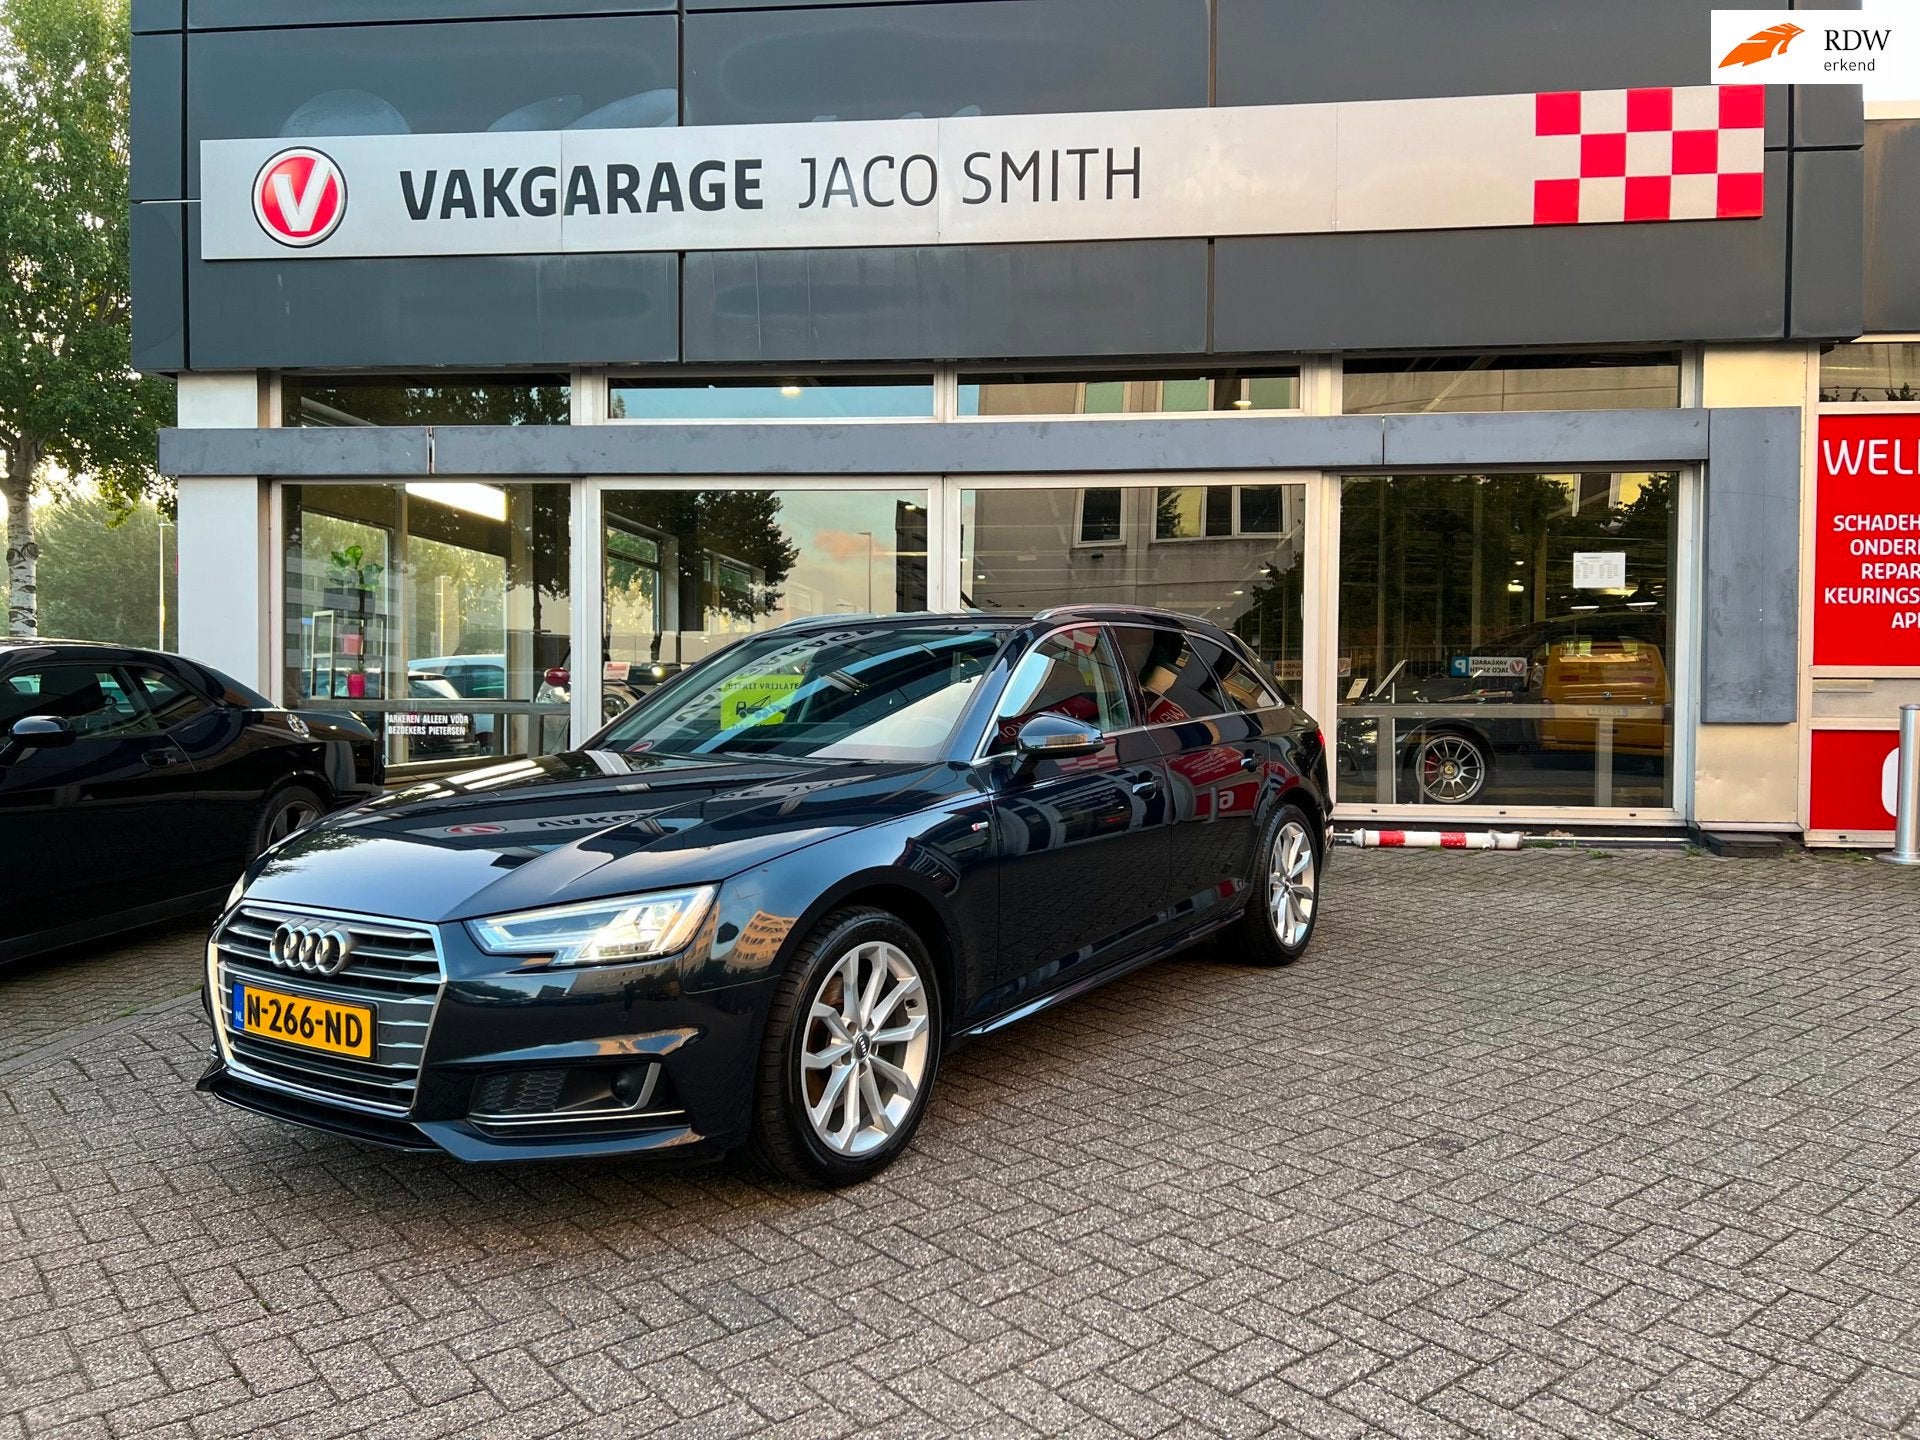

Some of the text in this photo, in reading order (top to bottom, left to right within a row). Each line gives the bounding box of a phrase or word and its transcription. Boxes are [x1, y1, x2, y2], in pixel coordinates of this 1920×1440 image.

[400, 147, 1141, 220] VAKGARAGE JACO SMITH
[1823, 439, 1920, 476] WEL
[1850, 538, 1920, 556] ONDER
[1891, 611, 1920, 629] AP
[422, 714, 448, 724] ALLEEN
[388, 725, 466, 736] BEZOEKERS PIETERSEN
[247, 994, 363, 1048] N-266-ND
